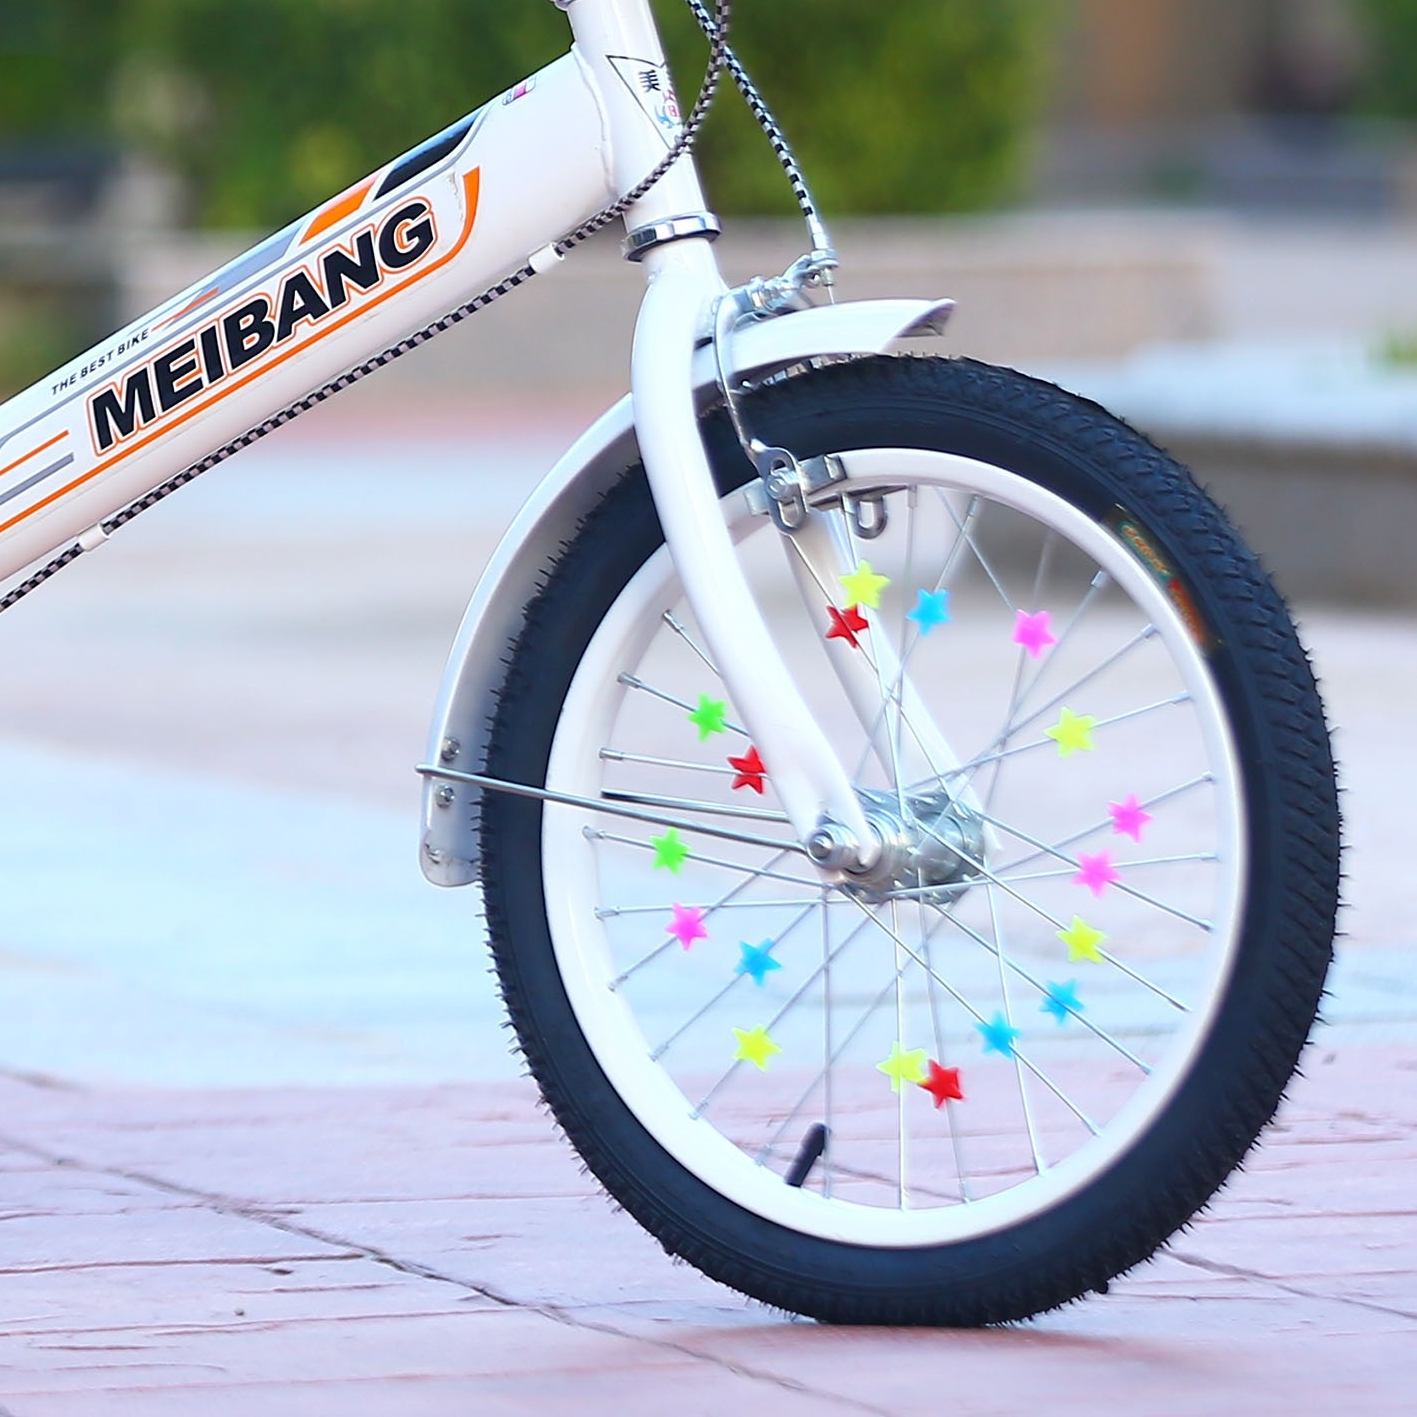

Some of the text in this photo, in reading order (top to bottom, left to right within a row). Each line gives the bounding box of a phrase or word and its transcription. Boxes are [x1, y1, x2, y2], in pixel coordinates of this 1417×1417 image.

[51, 327, 149, 395] THE BEST BIKE
[89, 201, 435, 452] MEIBANG
